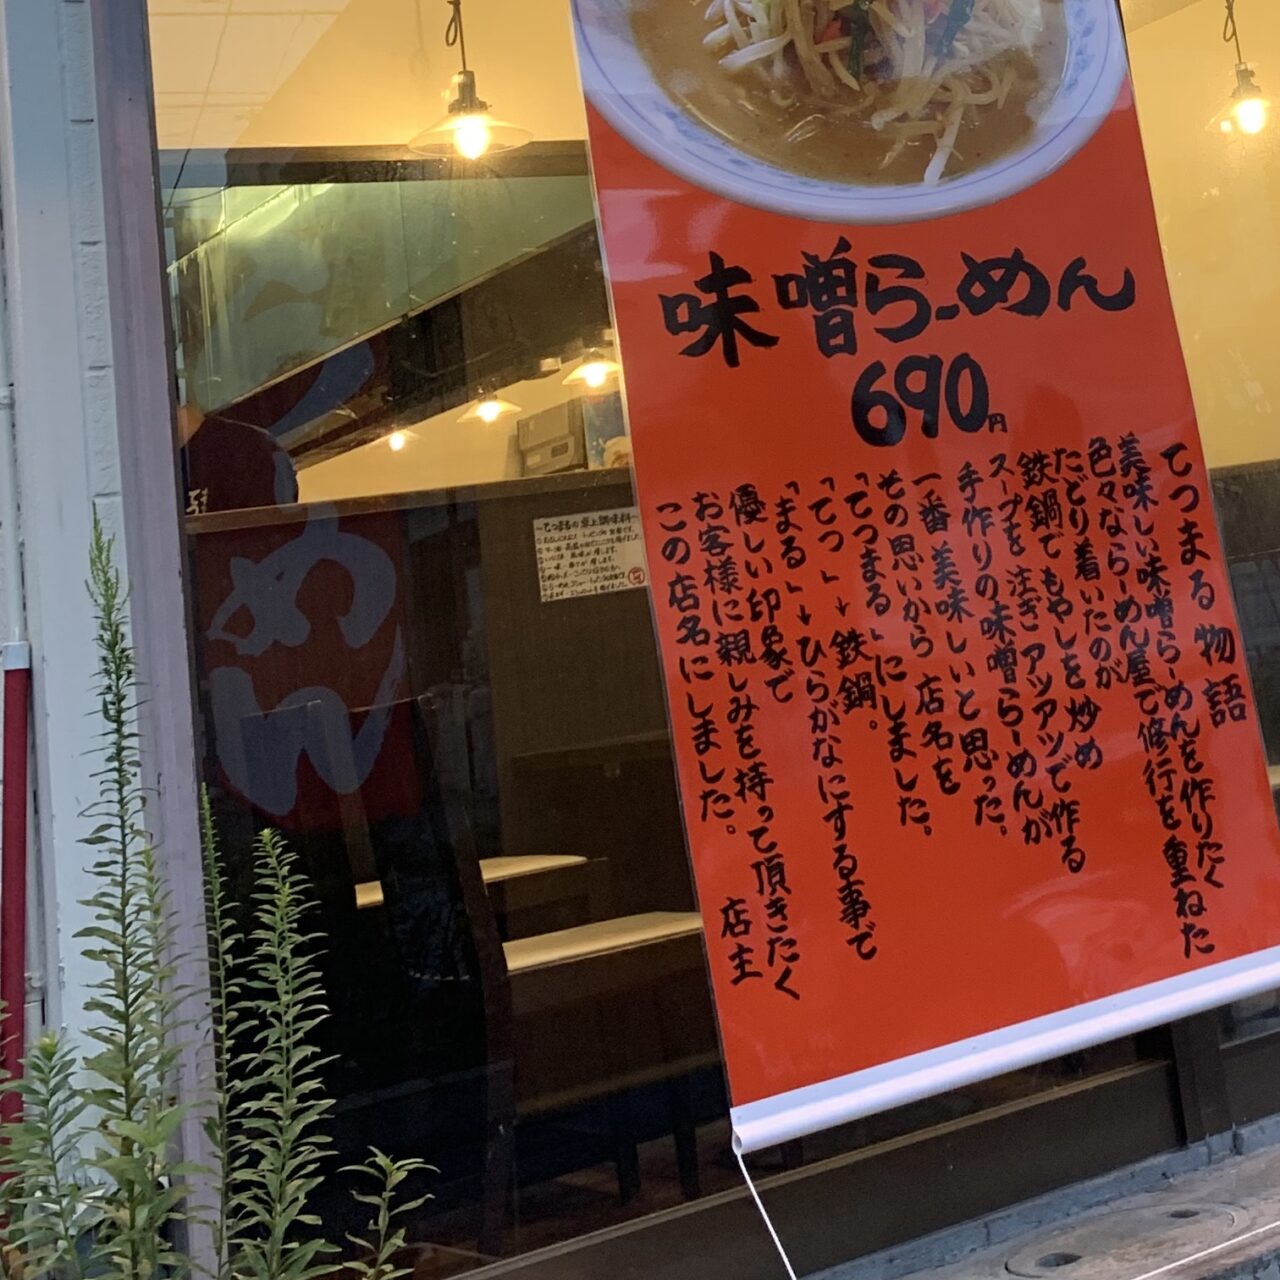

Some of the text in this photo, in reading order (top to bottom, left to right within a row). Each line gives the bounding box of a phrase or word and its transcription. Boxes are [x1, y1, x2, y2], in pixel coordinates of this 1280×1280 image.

[658, 235, 1136, 368] 味噌らーめん
[850, 352, 1009, 447] 690円
[656, 502, 736, 835] この店名にしました。
[728, 483, 796, 704] 優しい印象で
[877, 468, 961, 795] その思いから店名を
[957, 461, 1052, 846] 手作りの味噌らーめんが
[1016, 449, 1103, 770] 鉄鍋でもやしを炒め
[1052, 447, 1128, 690] たどり着いたのが
[1117, 431, 1225, 888] 美味しい味噌らーめんを作りたく
[1160, 442, 1247, 728] てつまる物語
[691, 491, 800, 1001] お客様に親しみを持って頂きたく
[720, 896, 763, 986] 店主
